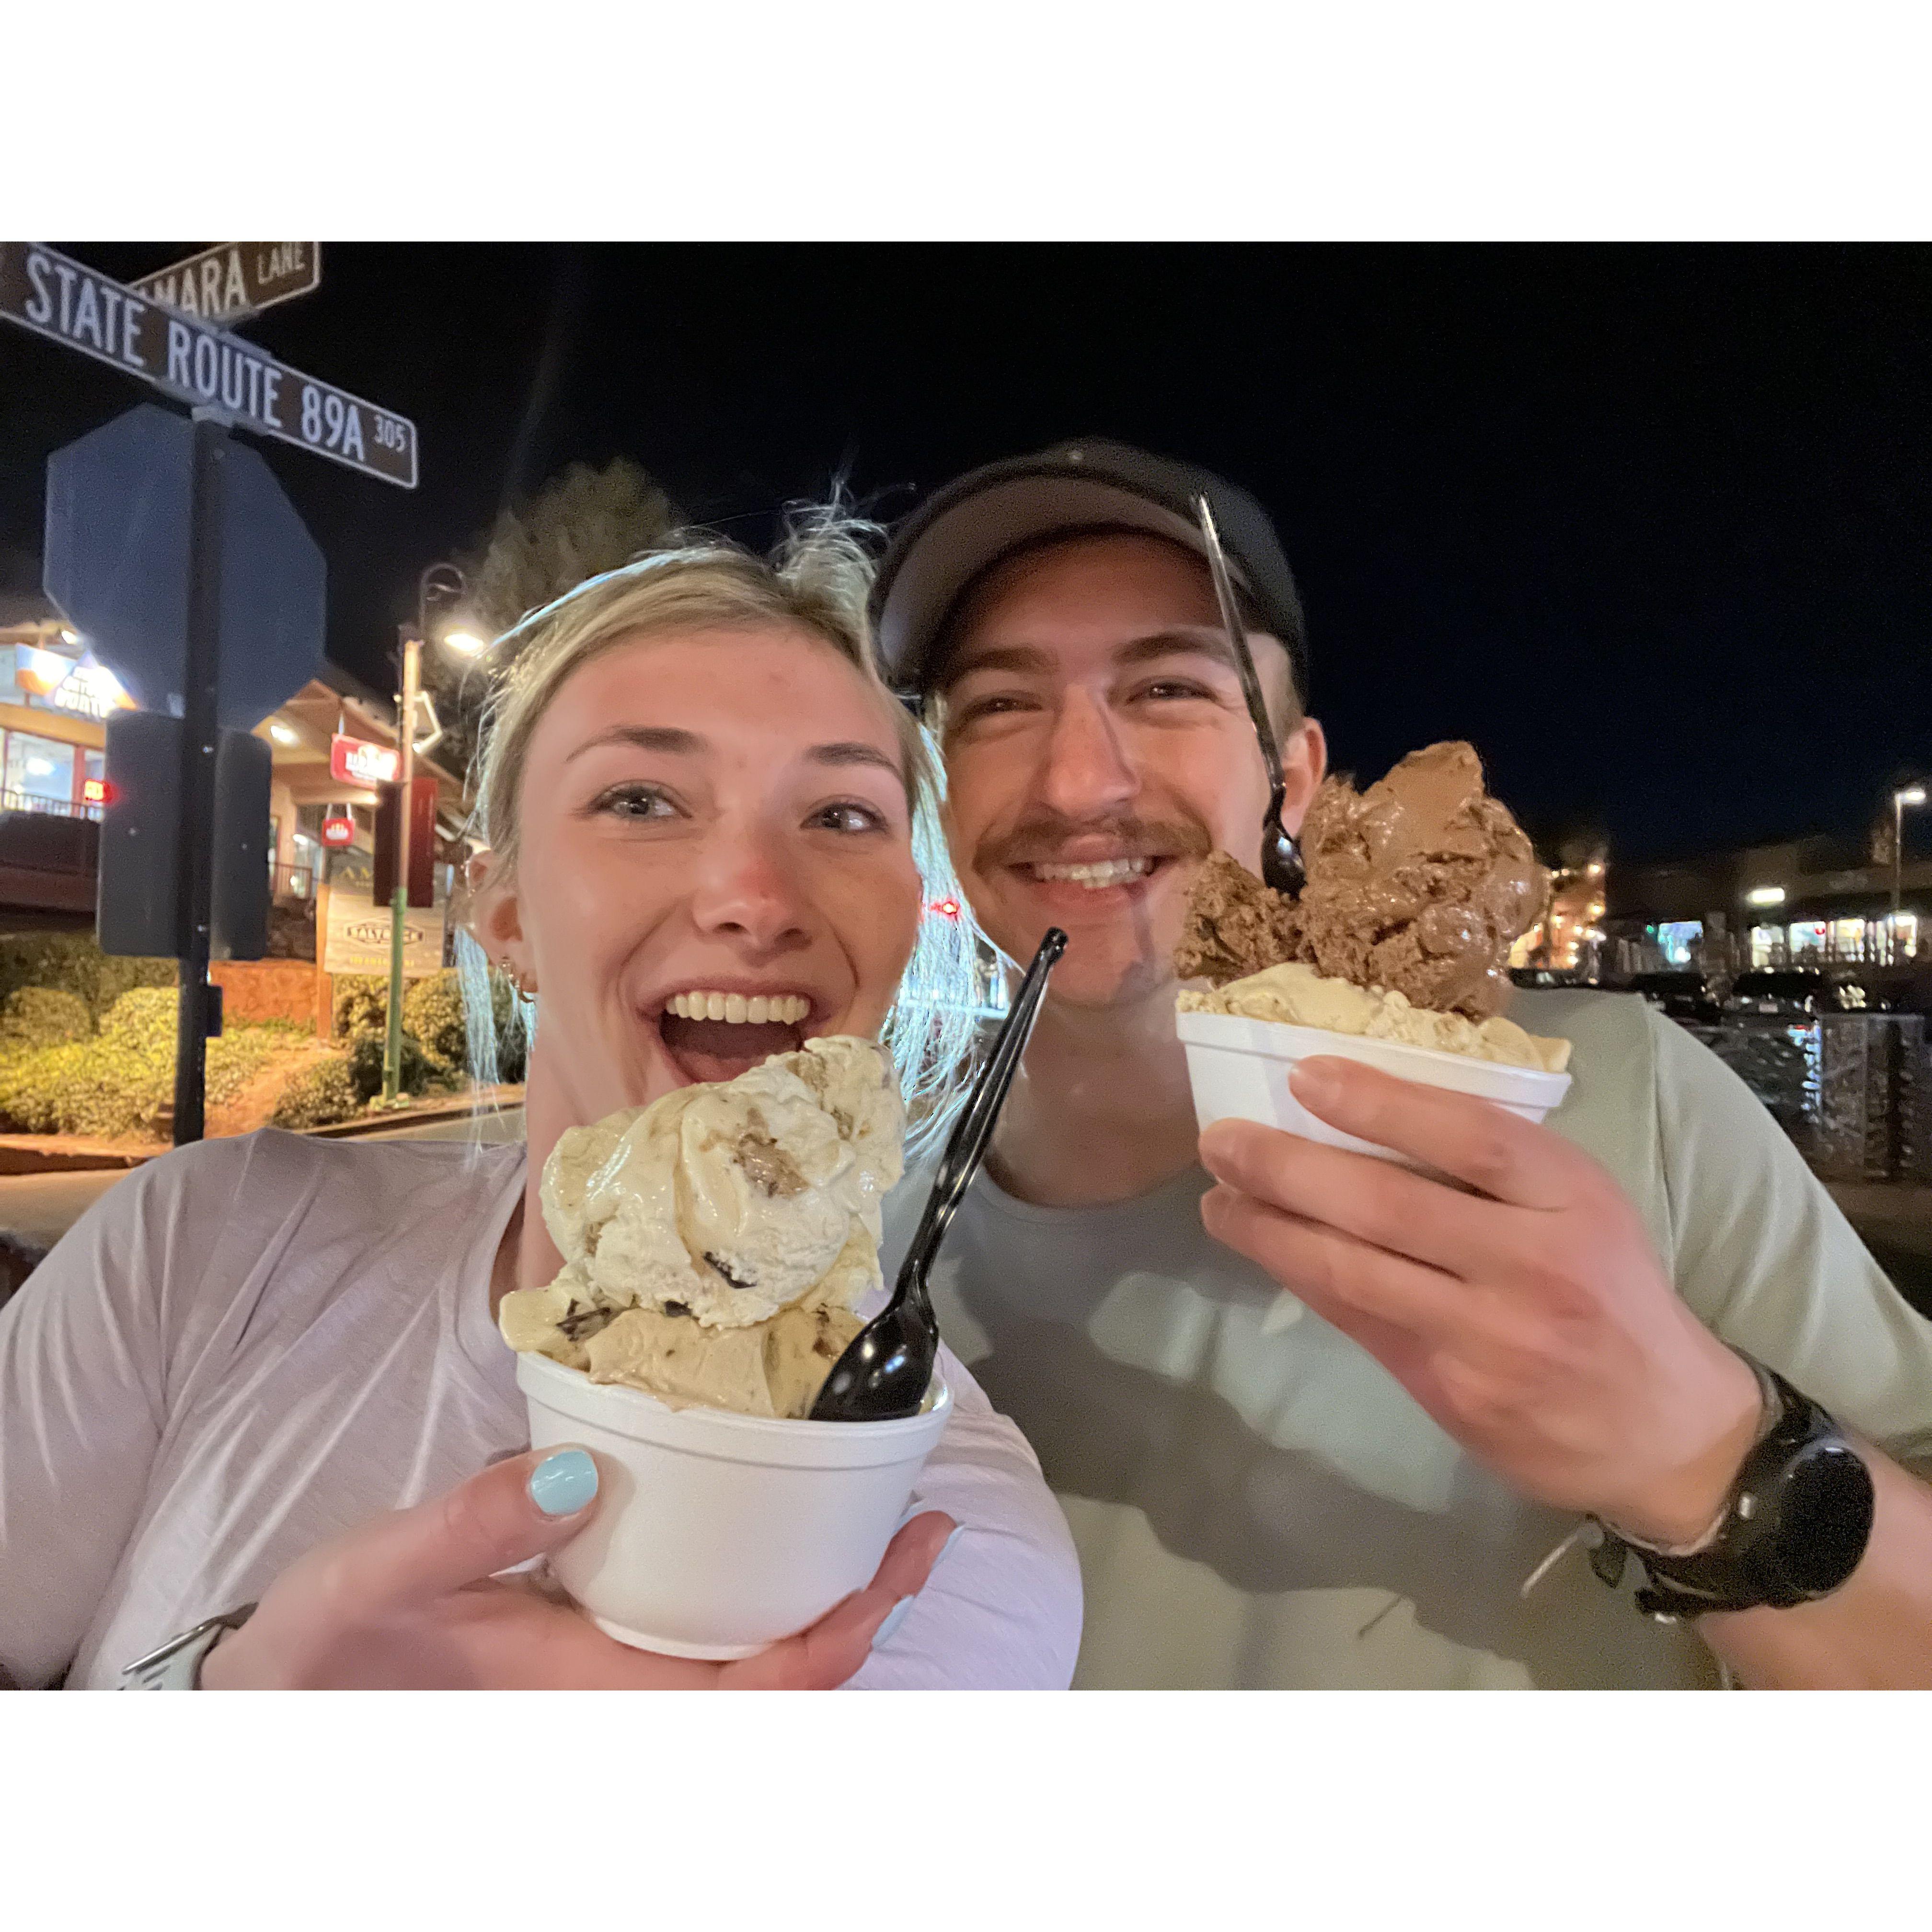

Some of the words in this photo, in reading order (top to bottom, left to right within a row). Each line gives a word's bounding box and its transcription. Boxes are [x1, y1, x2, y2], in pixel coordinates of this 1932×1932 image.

[138, 250, 247, 318] MARA
[257, 242, 306, 285] LANE
[25, 252, 146, 367] STATE
[168, 320, 283, 427] ROUTE
[302, 385, 365, 462] 89A
[374, 414, 406, 453] 305
